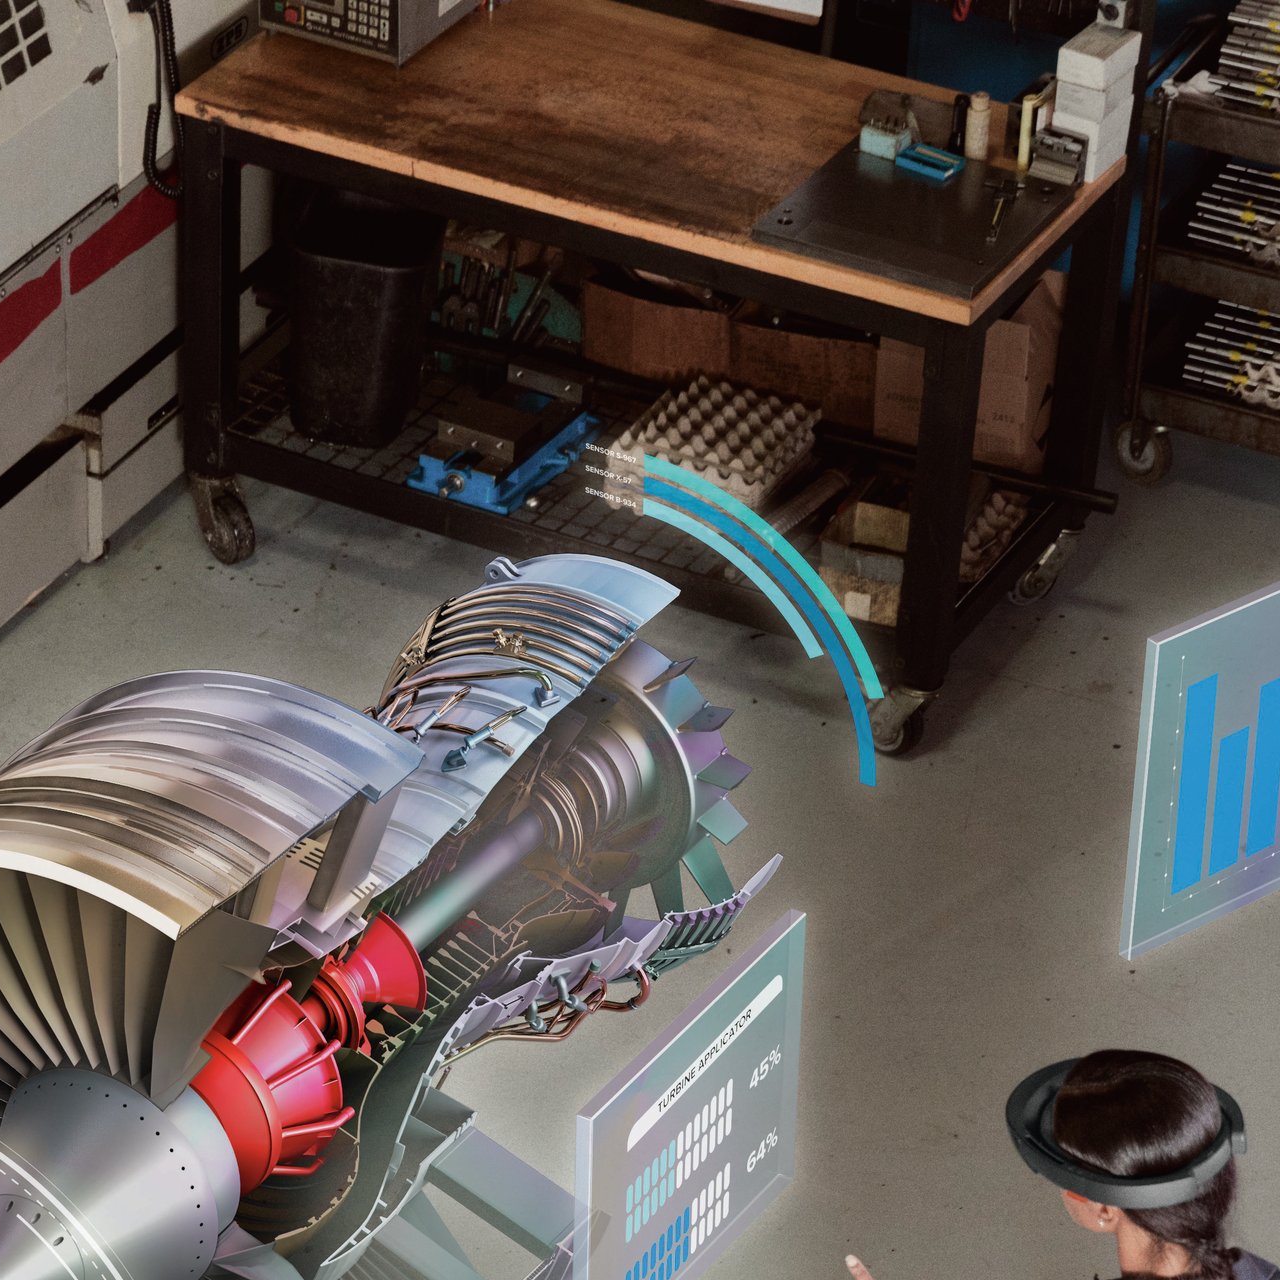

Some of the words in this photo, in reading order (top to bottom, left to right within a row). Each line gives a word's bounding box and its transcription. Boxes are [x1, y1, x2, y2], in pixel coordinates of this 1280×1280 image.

[658, 1066, 696, 1114] TURBINE
[698, 1008, 753, 1071] APPLICATOR
[748, 1044, 782, 1091] 45%
[746, 1126, 779, 1174] 64%
